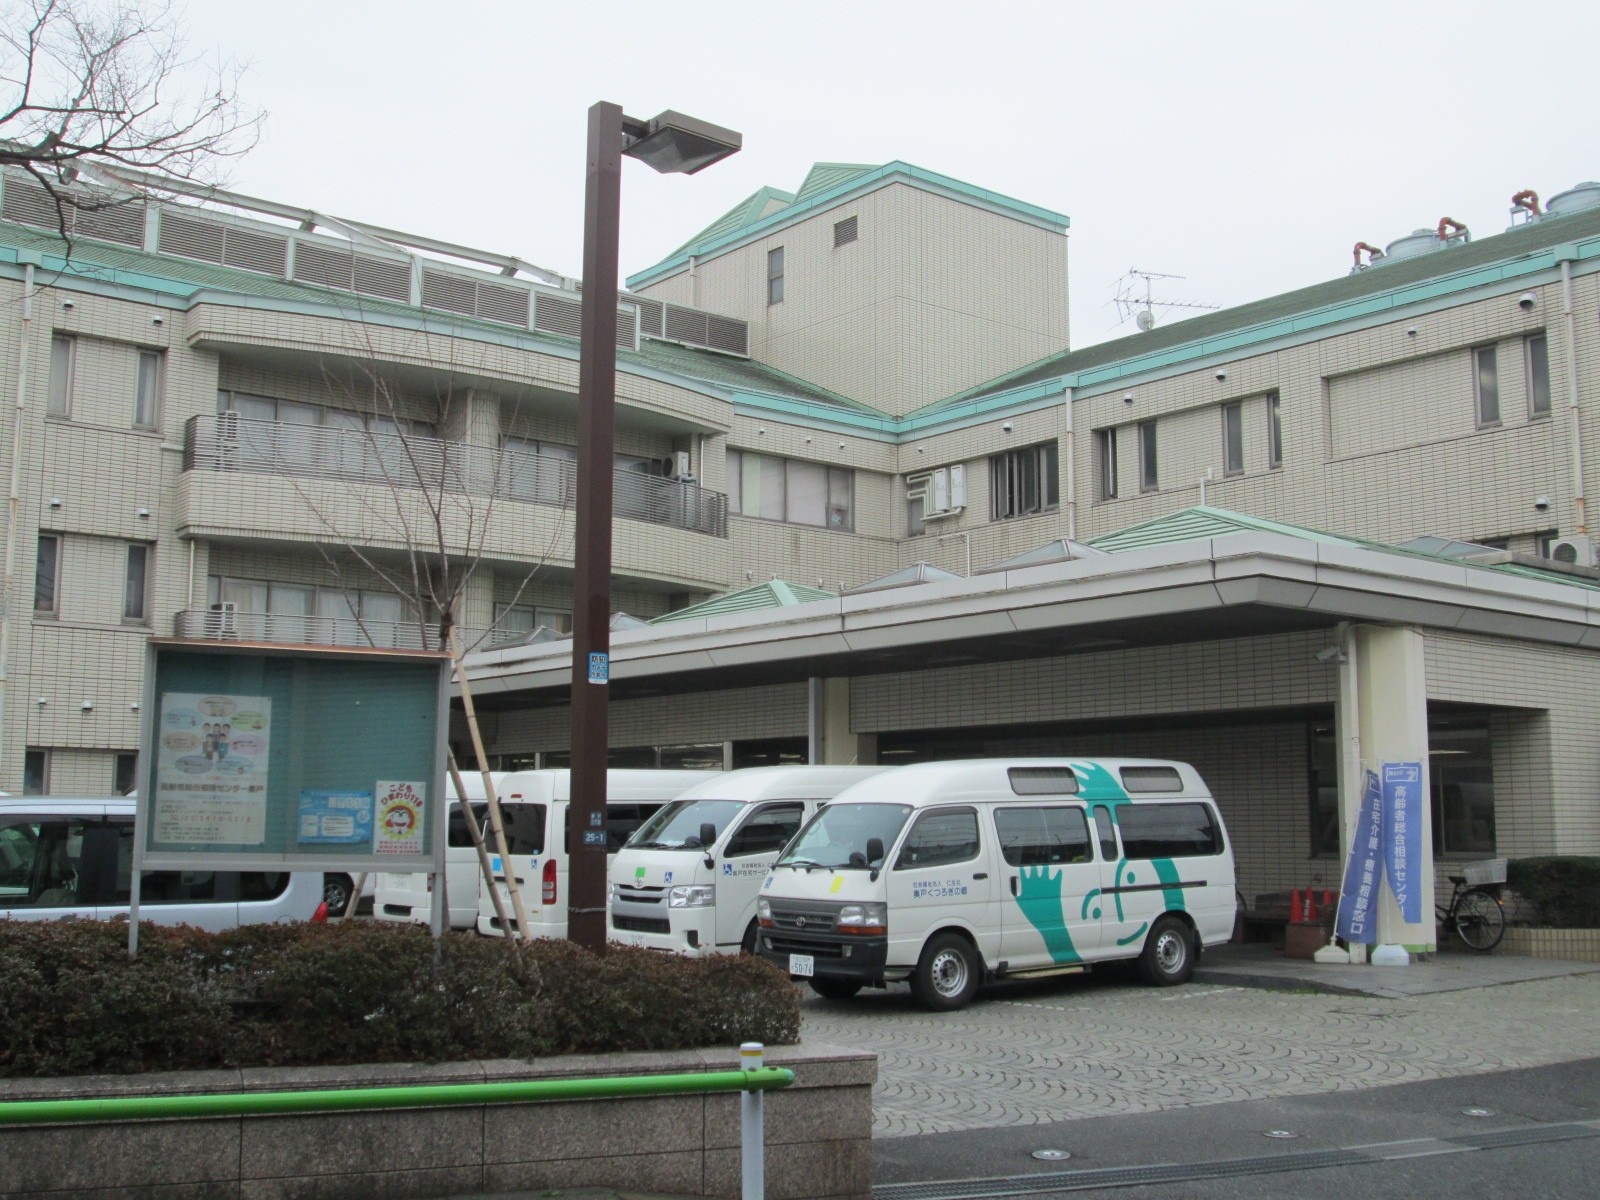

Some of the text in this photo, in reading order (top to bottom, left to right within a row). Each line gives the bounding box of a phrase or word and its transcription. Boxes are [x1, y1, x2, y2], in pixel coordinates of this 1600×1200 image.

[592, 655, 606, 663] 防犯
[389, 783, 413, 793] こども
[586, 833, 603, 842] 25-1
[1394, 786, 1407, 915] 高齢者総合相談センター
[913, 886, 968, 898] 奥戸くつろぎの郷
